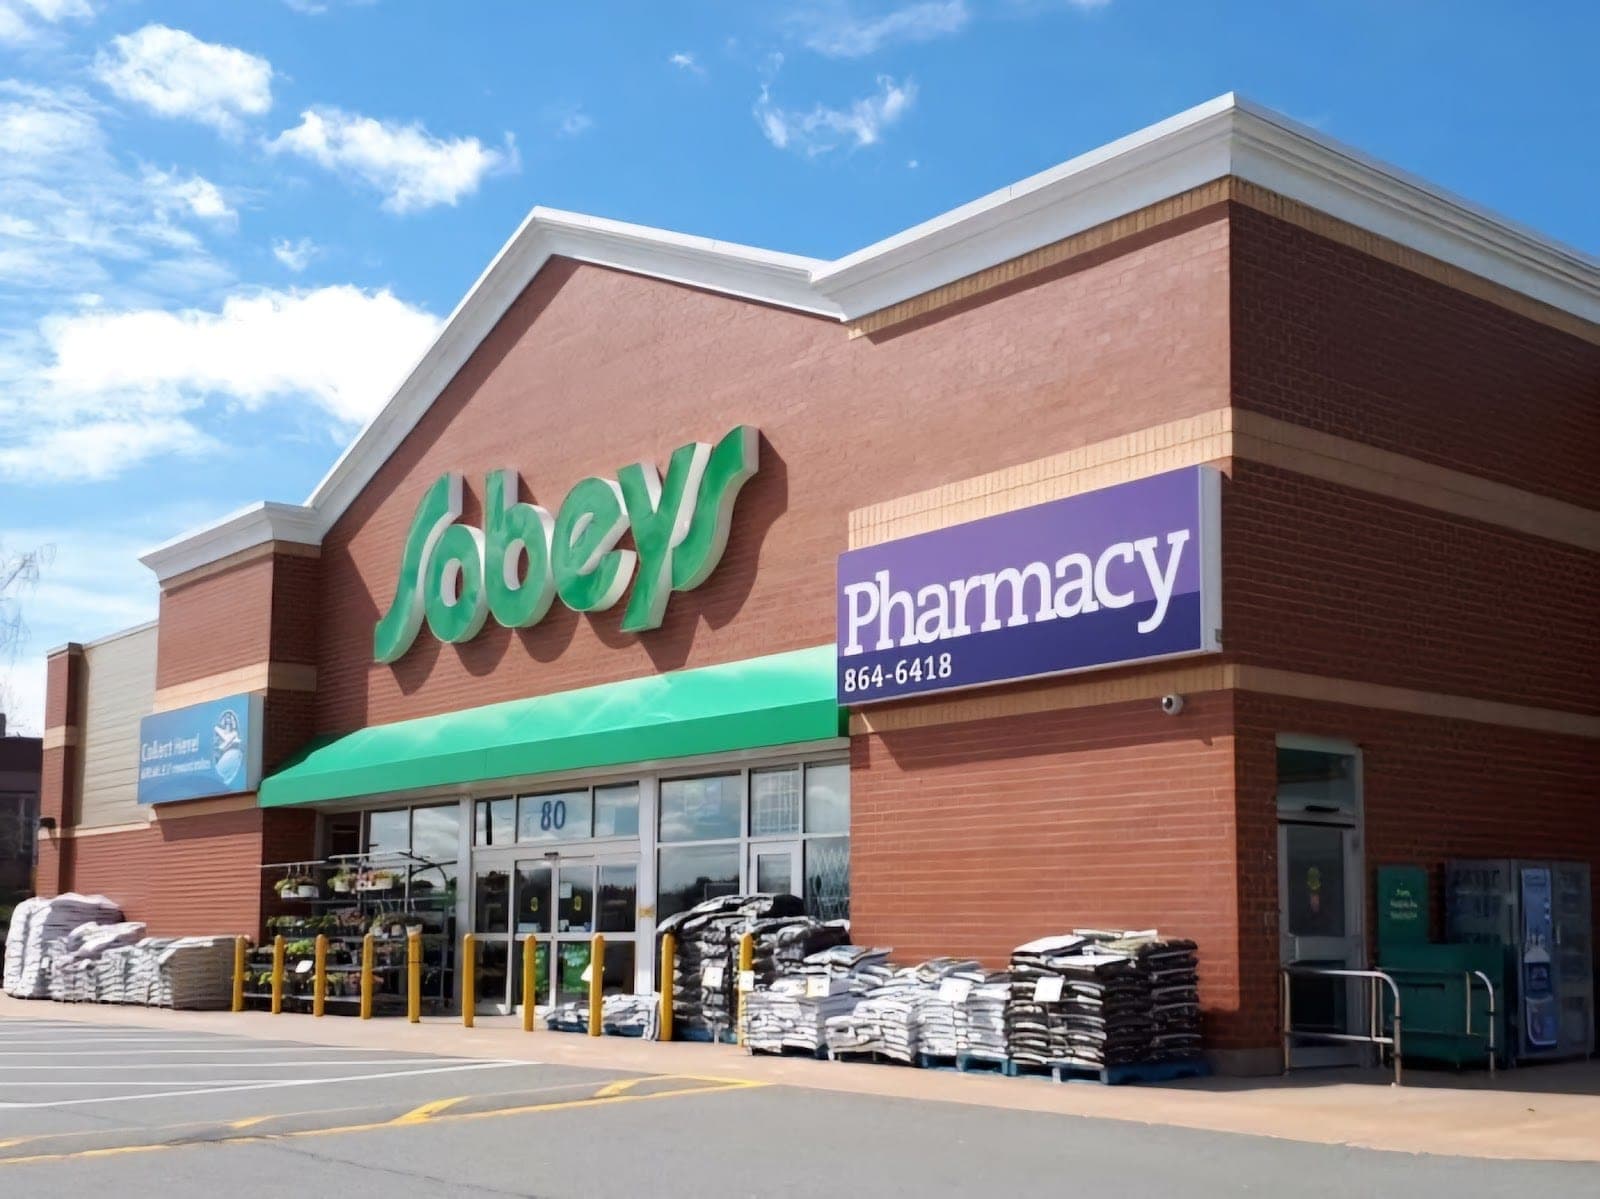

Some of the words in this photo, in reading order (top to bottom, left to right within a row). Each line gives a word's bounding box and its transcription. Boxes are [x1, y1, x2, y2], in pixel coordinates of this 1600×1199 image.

[373, 425, 760, 664] Sobeys
[844, 529, 1190, 657] Pharmacy
[844, 652, 952, 693] 864-6418
[540, 799, 566, 831] 80
